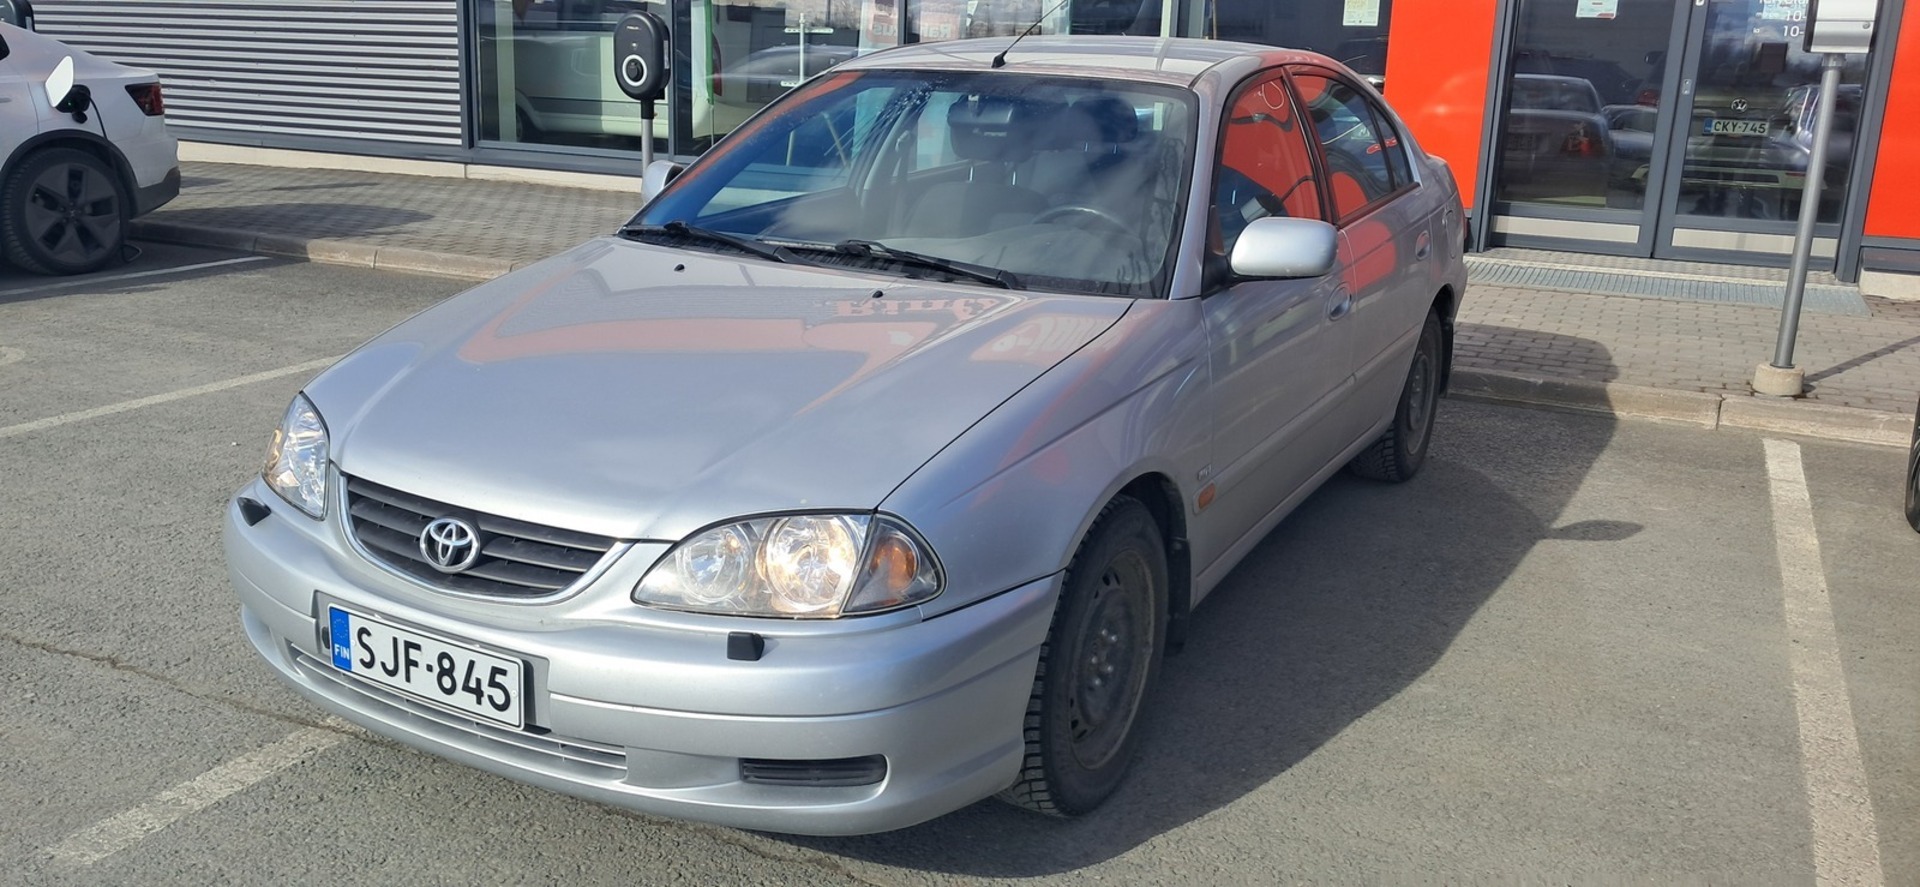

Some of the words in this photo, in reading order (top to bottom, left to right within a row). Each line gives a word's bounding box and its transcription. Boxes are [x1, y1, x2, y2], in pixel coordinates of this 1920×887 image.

[1714, 121, 1766, 133] CKY-745
[334, 644, 350, 660] FIN
[357, 627, 511, 712] SJF-845
